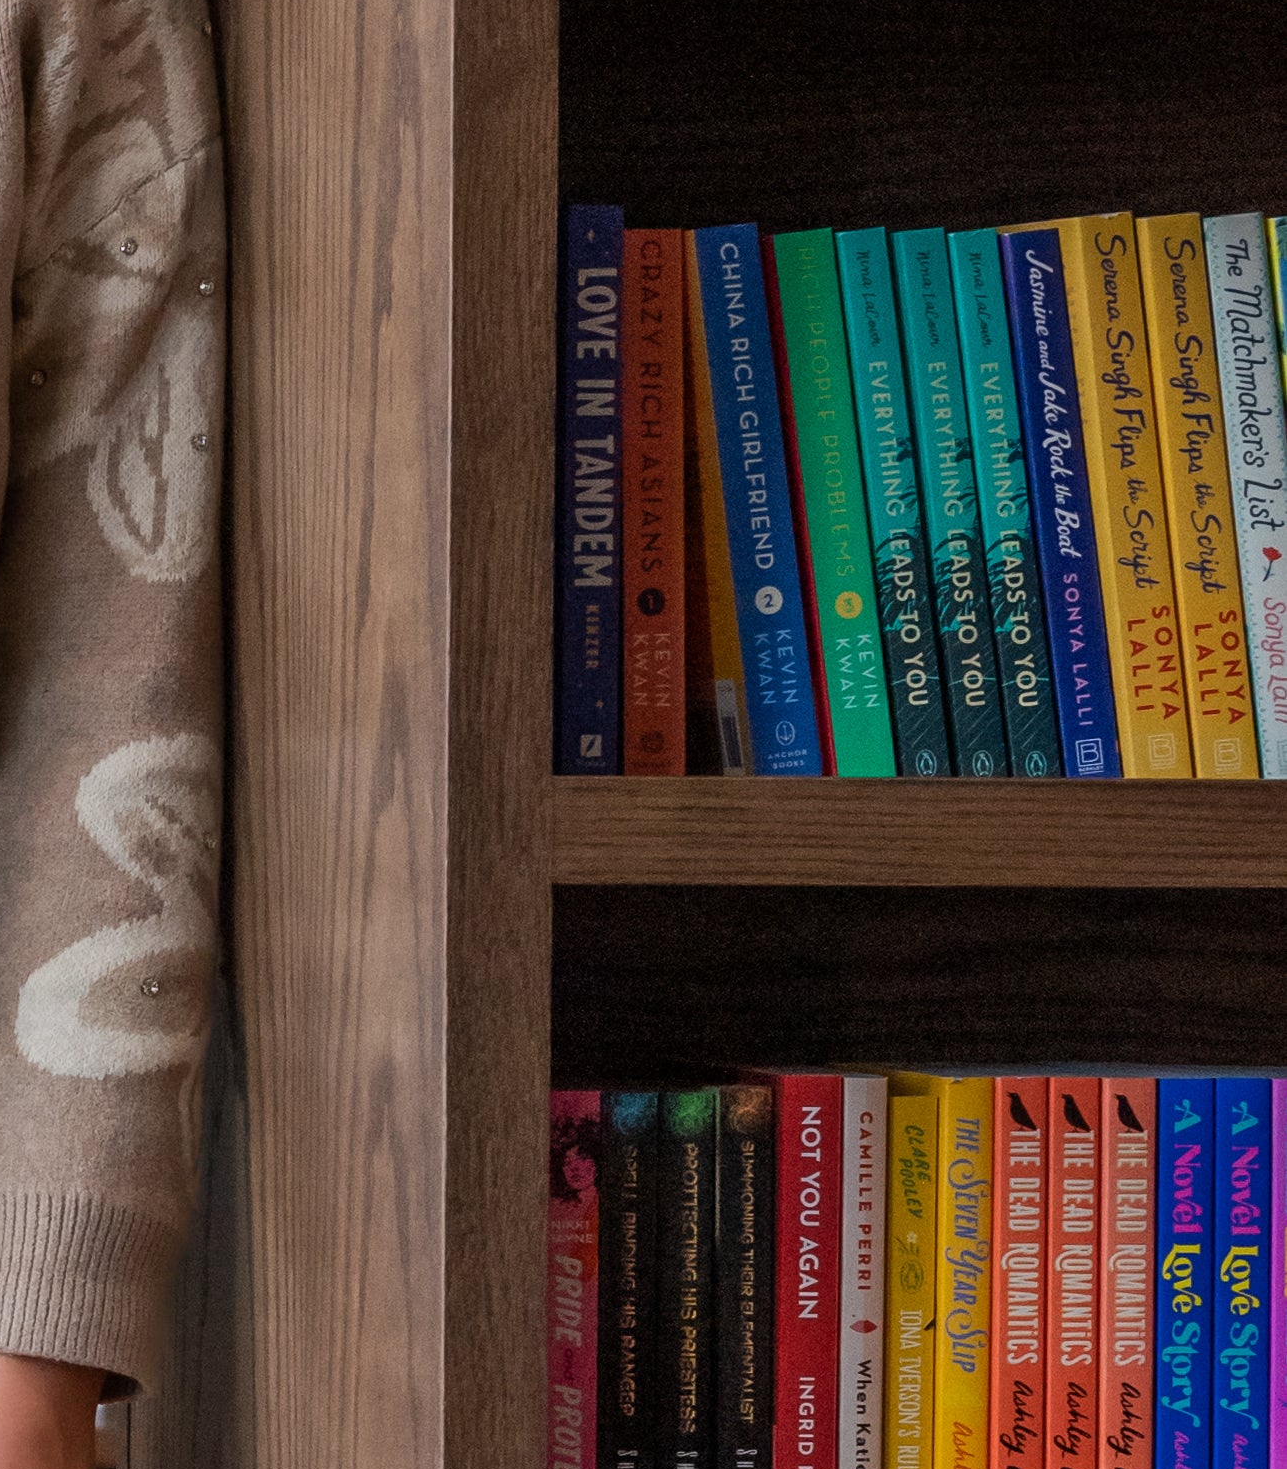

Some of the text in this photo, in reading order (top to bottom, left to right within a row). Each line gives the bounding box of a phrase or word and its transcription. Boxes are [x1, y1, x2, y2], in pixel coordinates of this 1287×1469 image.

[574, 267, 618, 587] LOVE IN TANDEM
[639, 240, 664, 573] CRAZY RICH ASIANS
[719, 242, 774, 569] CHINA RICH GIRLFRIEND
[1025, 248, 1083, 560] Jasmine and Jake Rock the Boat
[1094, 232, 1160, 590] Serena Singh Flips the Script
[1224, 238, 1286, 532] The Matchmaker's List
[868, 360, 929, 706] EVERYTHING LEADS TO YOU
[763, 593, 774, 608] 2
[1063, 572, 1094, 727] SONYA LALLI
[754, 634, 776, 704] KWAN
[776, 629, 798, 704] KEVIN
[1127, 618, 1155, 712] LALLI
[1151, 605, 1181, 721] SONYA
[1262, 597, 1287, 724] Sonya Lalli
[857, 1110, 873, 1291] CAMILLE PERRI
[899, 1158, 923, 1220] POOLEY
[904, 1124, 930, 1183] CLARE
[1009, 1128, 1041, 1168] THE
[798, 1106, 822, 1320] NOT YOU AGAIN
[1008, 1177, 1041, 1231] DEAD
[554, 1254, 583, 1347] PRIDE
[1160, 1099, 1203, 1428] A Novel Love Story
[899, 1309, 923, 1351] IONA
[798, 1376, 816, 1457] INGRID
[856, 1359, 872, 1415] When
[897, 1359, 922, 1439] IVERSON'S
